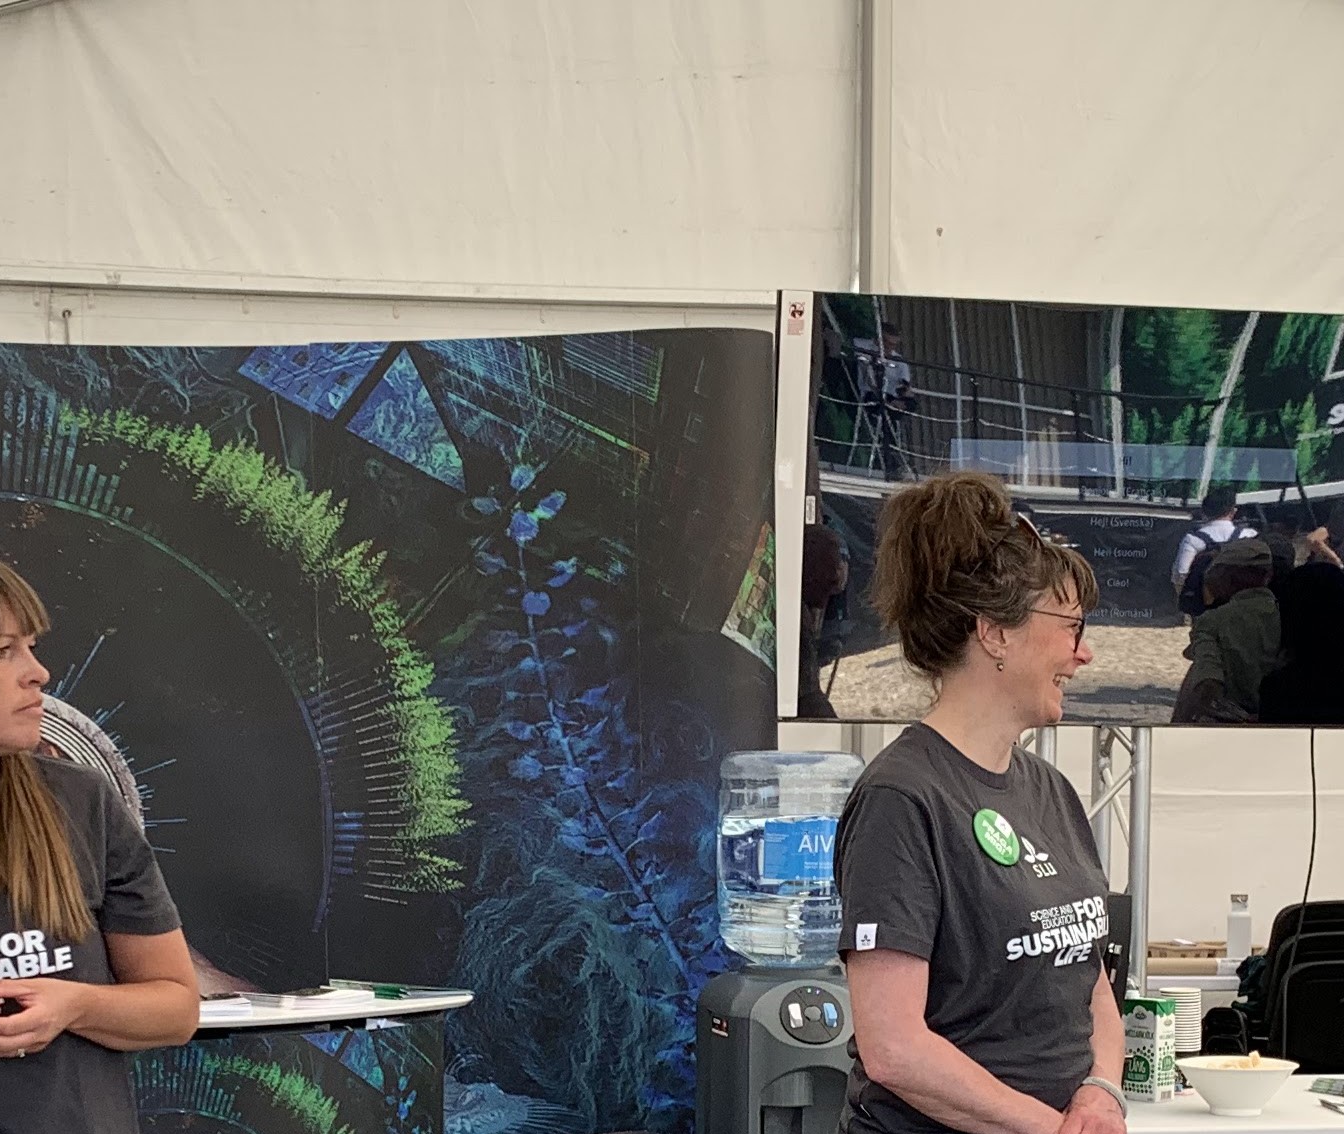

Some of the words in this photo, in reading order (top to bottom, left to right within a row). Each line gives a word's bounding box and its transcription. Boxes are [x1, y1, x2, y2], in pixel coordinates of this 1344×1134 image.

[1032, 862, 1058, 879] SLU
[1030, 906, 1059, 922] SCIENCE
[1072, 896, 1106, 922] FOR
[1041, 912, 1076, 930] EDUCATION
[1006, 914, 1109, 962] SUSTAINABL
[1054, 942, 1093, 967] LIFE
